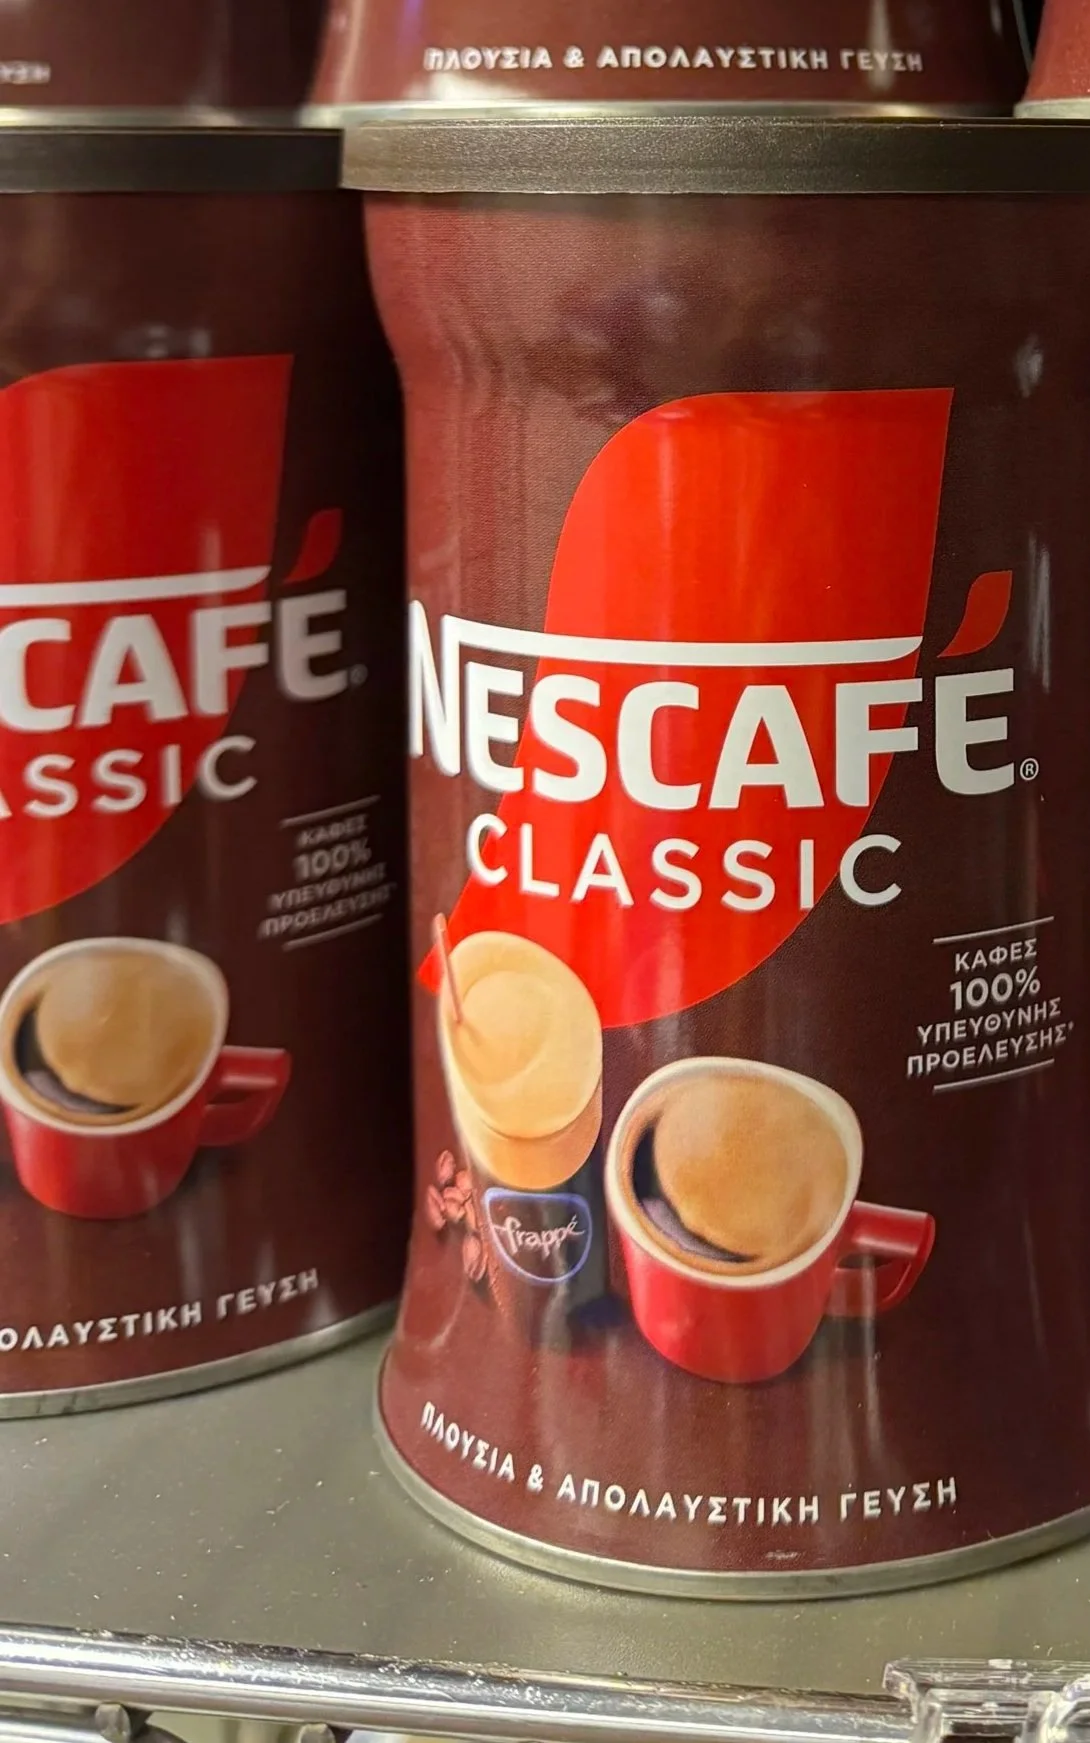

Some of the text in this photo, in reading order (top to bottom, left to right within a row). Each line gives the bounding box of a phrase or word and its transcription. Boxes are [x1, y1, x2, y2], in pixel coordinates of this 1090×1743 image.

[424, 45, 923, 71] ΠΛΟΥΣΙΑ & ΑΠΟΛΑΥΣΤΙΚΗ ΓΕΥΣΗ
[408, 570, 1014, 810] NESCAFÉ
[294, 837, 371, 880] 100%
[467, 813, 901, 912] CLASSIC
[955, 938, 1037, 972] ΚΑΦΕΣ
[950, 966, 1041, 1011] 100%
[917, 997, 1061, 1046] ΥΠΕΥΘΥΝΗΣ
[494, 1215, 585, 1257] frappé
[216, 1268, 319, 1320] ΓΕΥΣΗ
[421, 1401, 957, 1526] ΠΛΟΥΣΙΑ & ΑΠΟΛΑΥΣΤΙΚΗ ΓΕΥΣΗ
